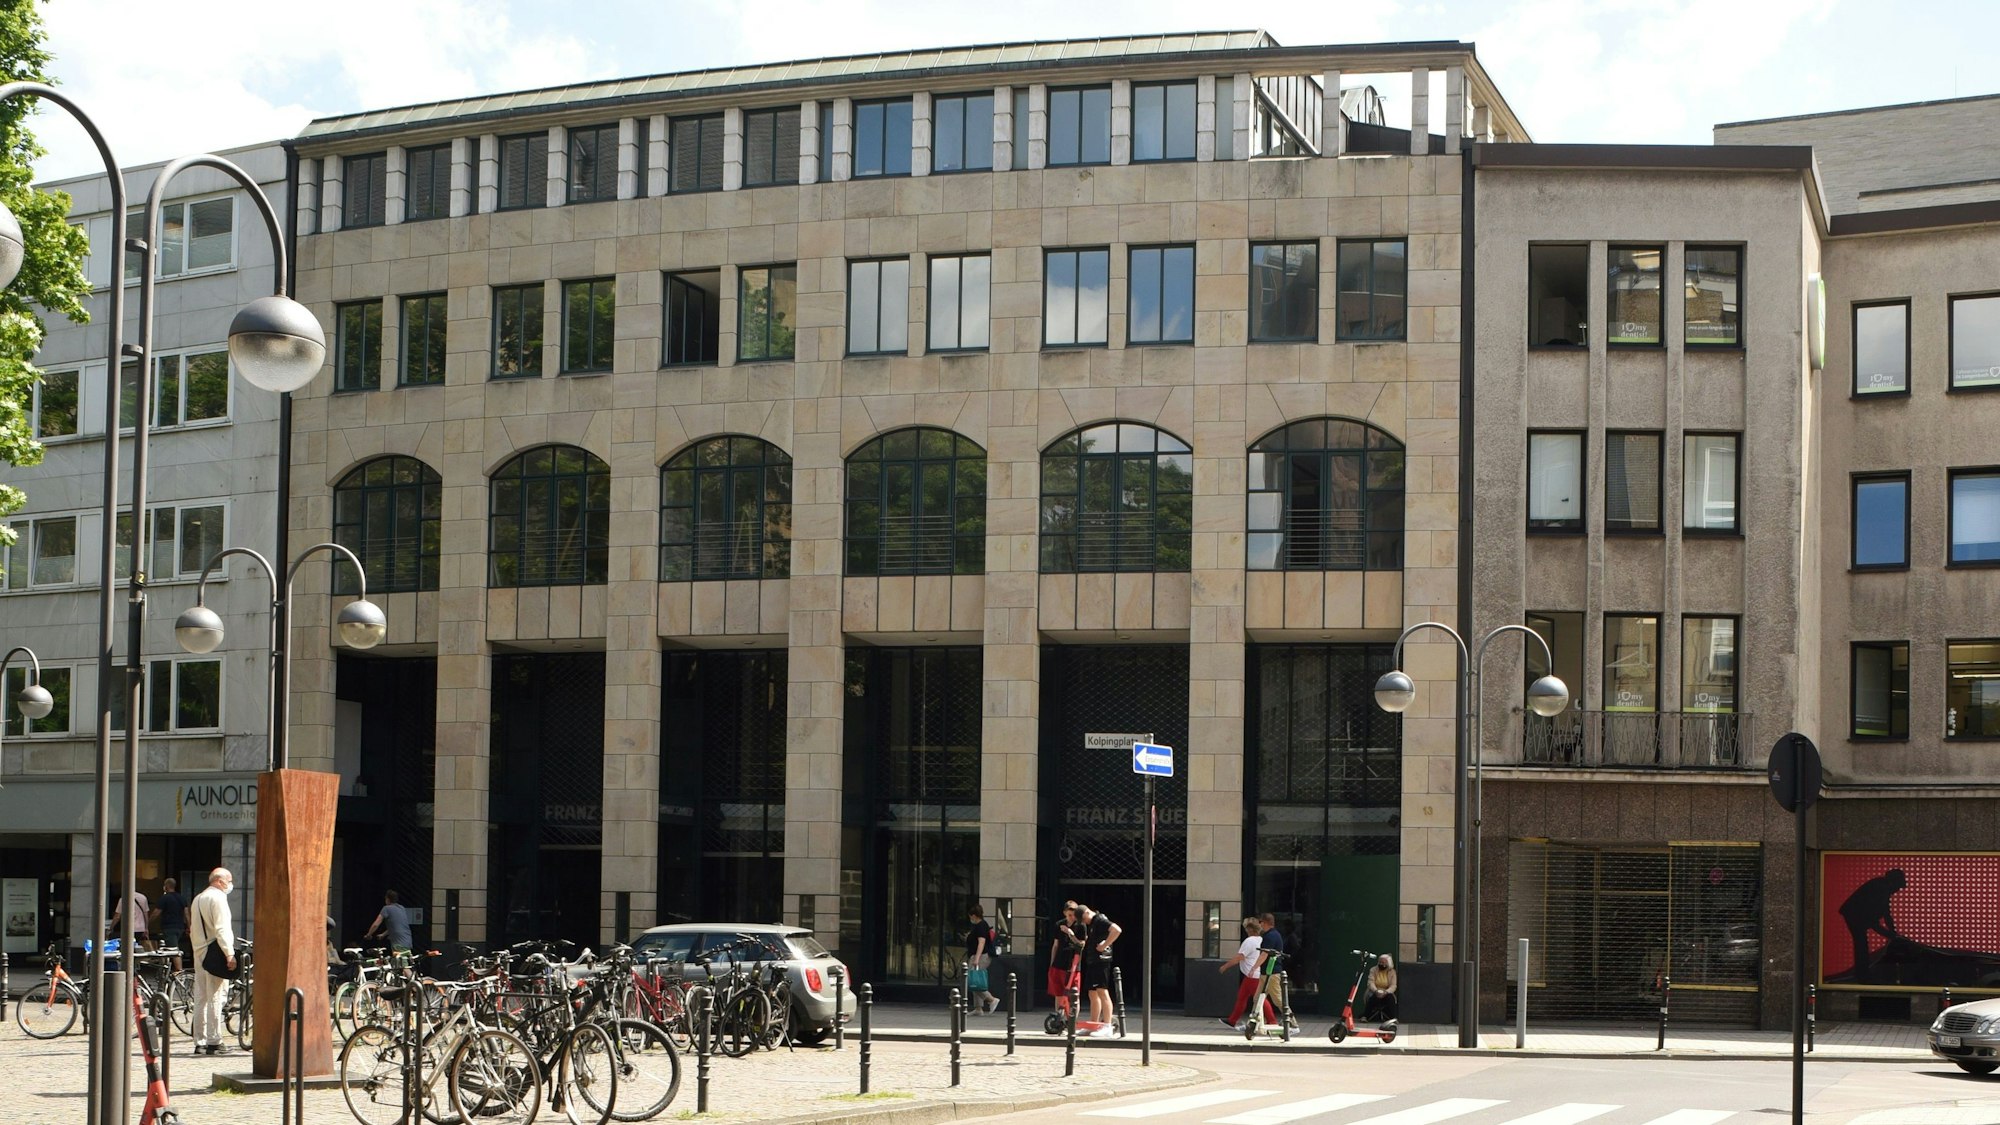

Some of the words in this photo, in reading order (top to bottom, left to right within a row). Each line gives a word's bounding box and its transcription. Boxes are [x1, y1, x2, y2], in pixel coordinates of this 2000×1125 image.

[1634, 324, 1647, 332] my
[139, 573, 145, 584] 2
[1708, 695, 1720, 703] my
[184, 785, 258, 806] AUNOLD
[545, 805, 598, 820] FRANZ
[1066, 807, 1128, 824] FRANZ
[1133, 807, 1186, 824] SUE
[1422, 806, 1433, 816] 13
